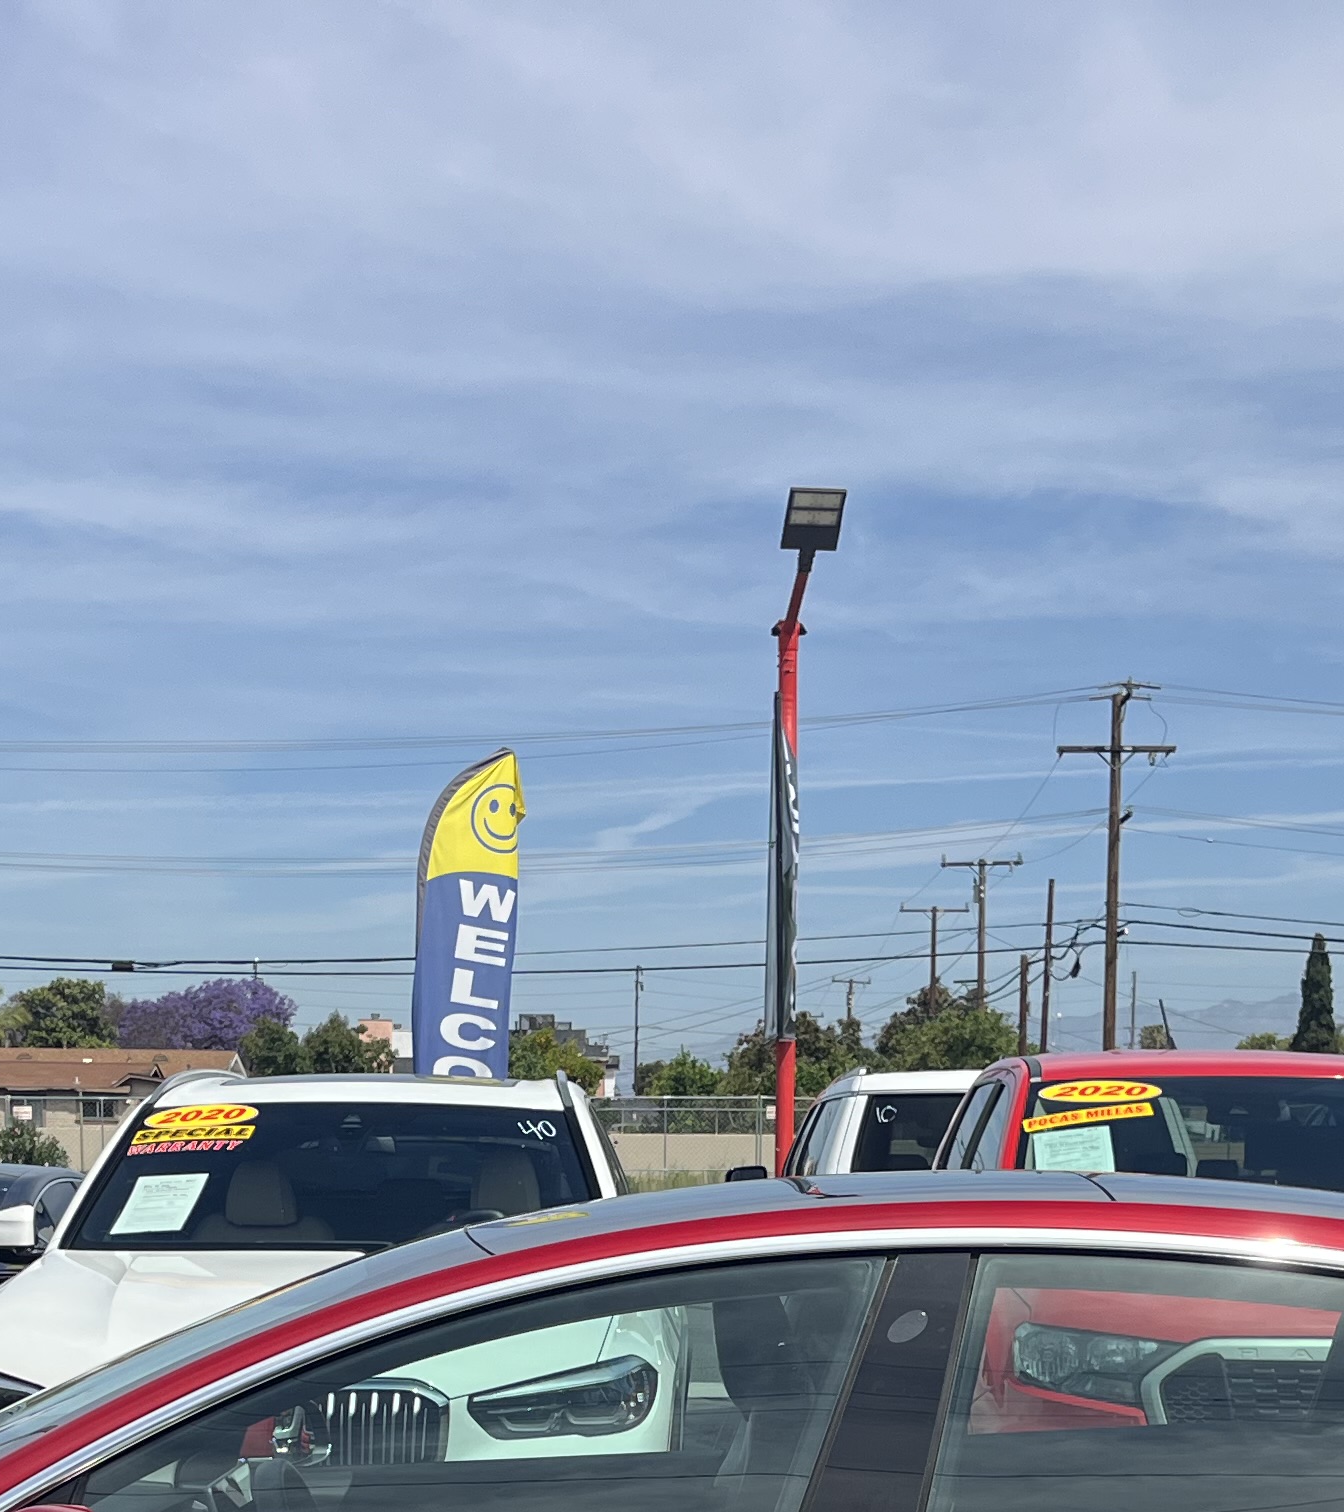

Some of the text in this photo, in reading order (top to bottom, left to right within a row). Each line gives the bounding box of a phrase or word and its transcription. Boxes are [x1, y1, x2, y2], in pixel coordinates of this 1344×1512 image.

[1054, 1086, 1148, 1097] 2020
[156, 1108, 247, 1124] 2020
[1028, 1105, 1145, 1128] POCAS MILLAS
[136, 1127, 251, 1141] SPECIAL
[517, 1120, 556, 1140] 40
[127, 1140, 243, 1156] WARRANTY
